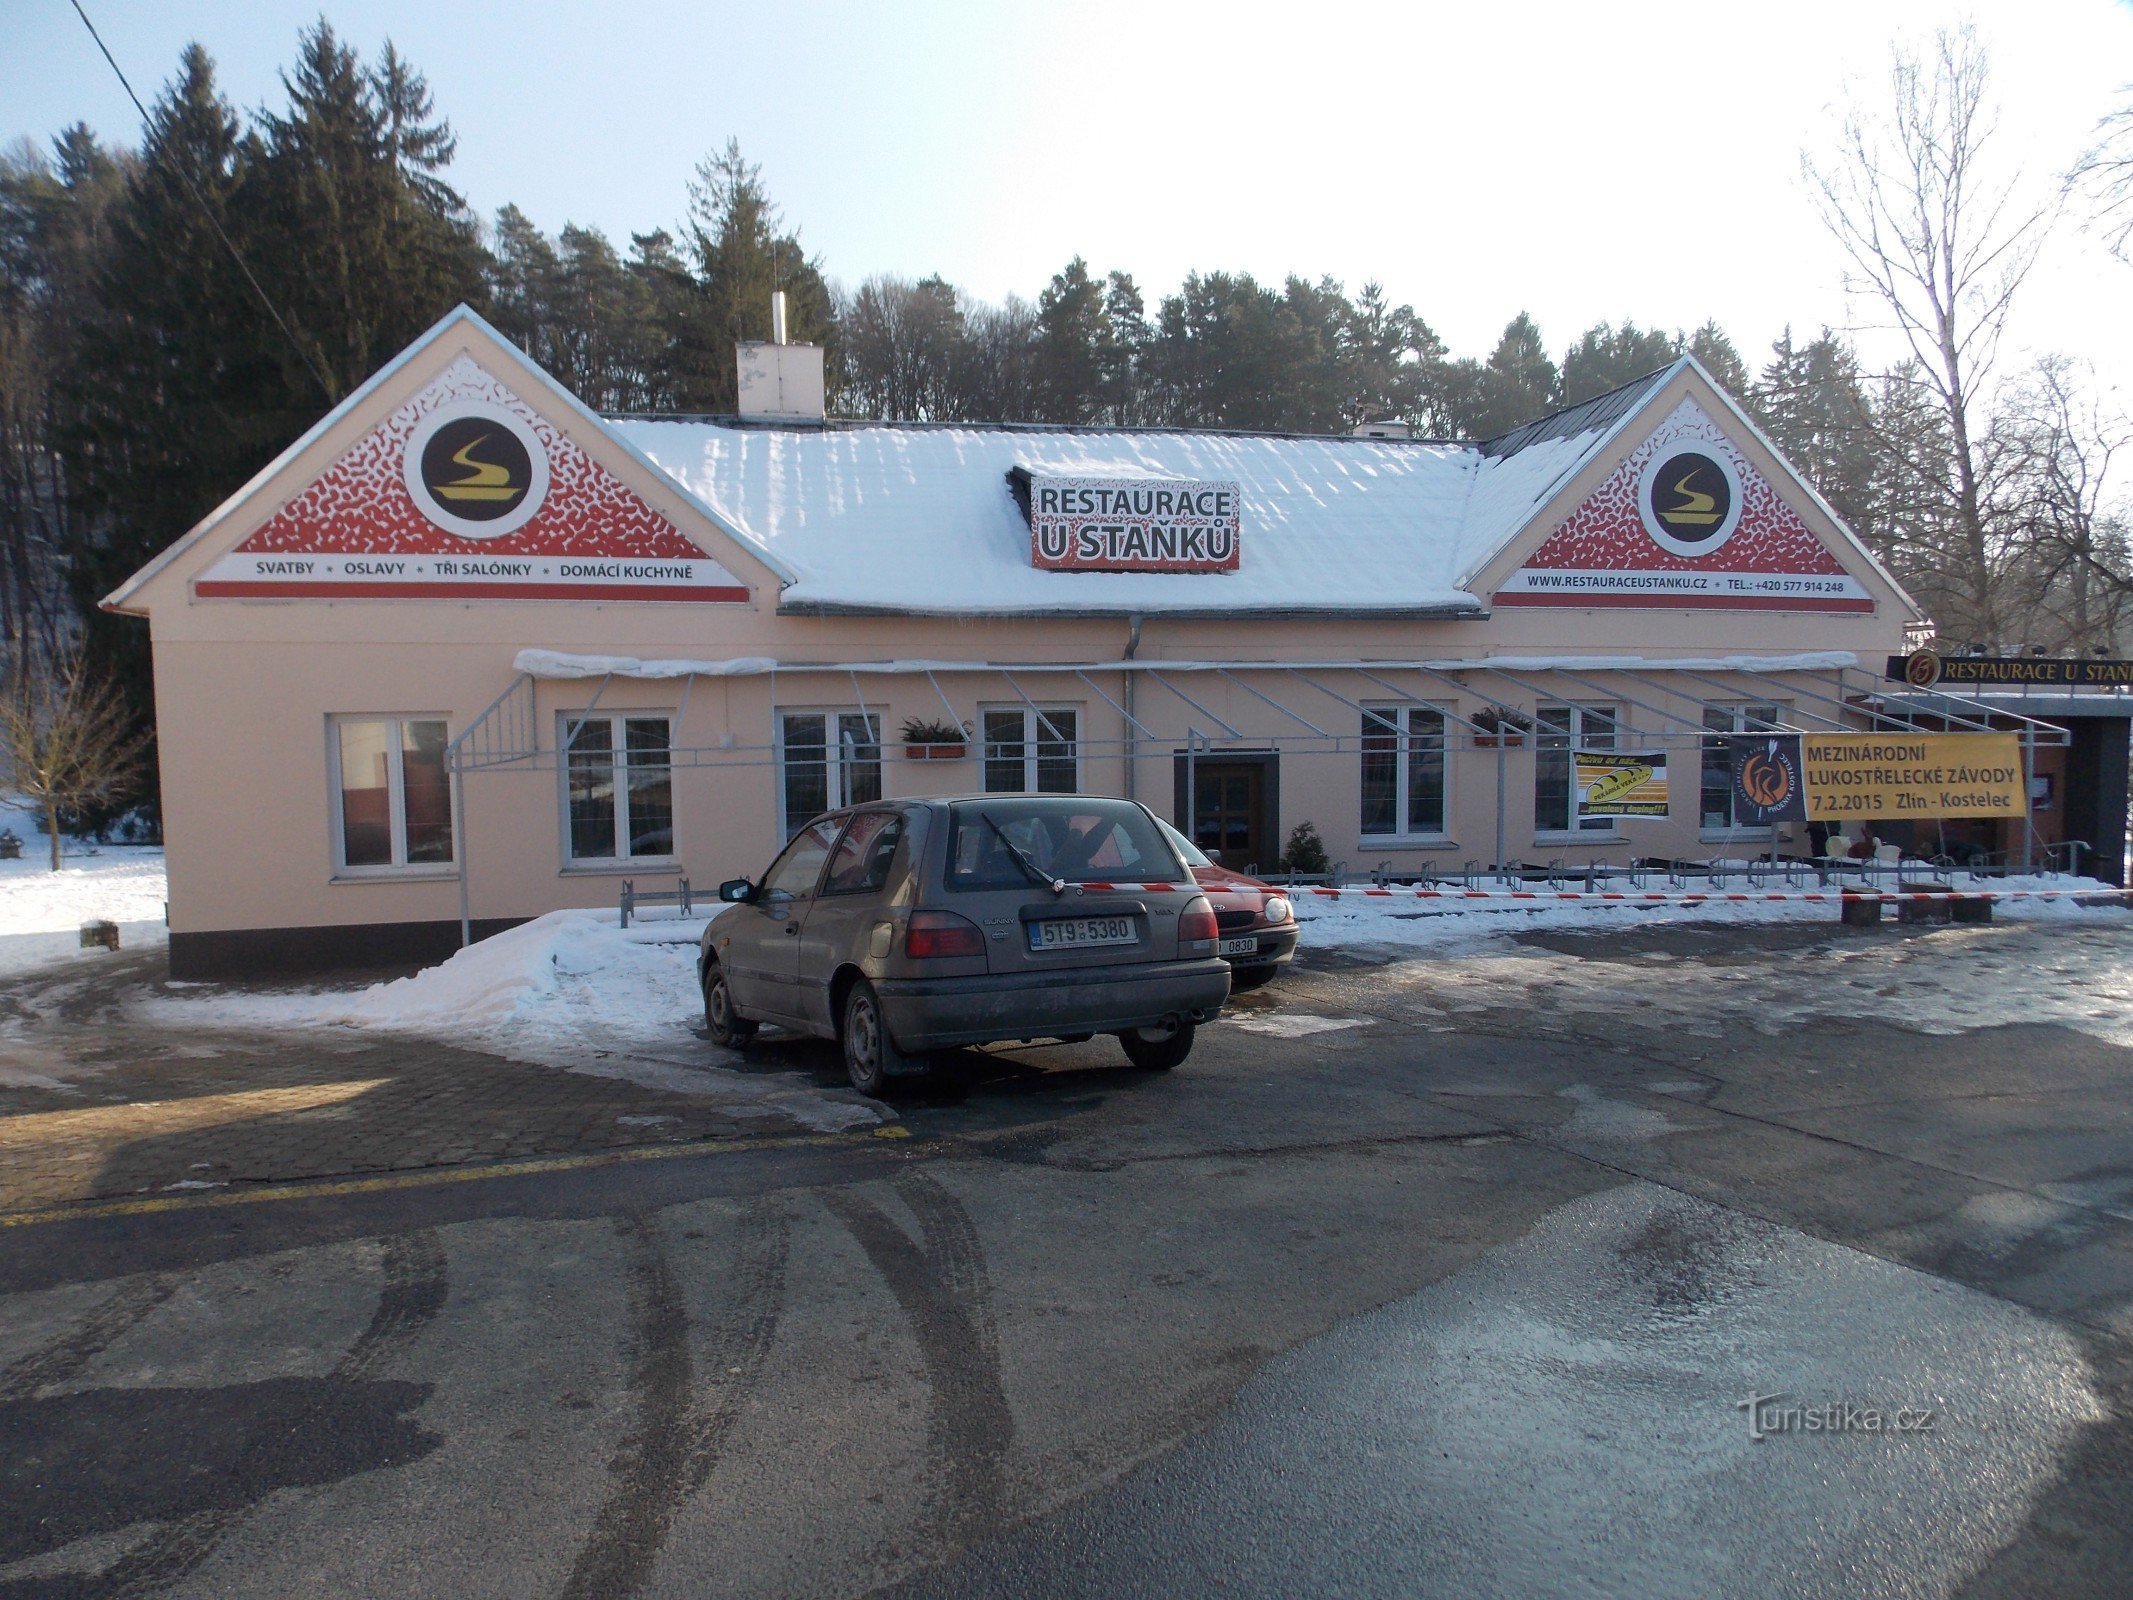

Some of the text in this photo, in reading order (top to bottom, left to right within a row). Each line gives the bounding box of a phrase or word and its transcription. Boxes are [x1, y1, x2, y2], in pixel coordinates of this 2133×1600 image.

[1040, 489, 1231, 517] RESTAURACE
[1041, 518, 1231, 559] U STAŇKŮ
[256, 561, 693, 578] SVATBY OSLAVY TŘI SALÓNKY DOMÁCÍ KUCHYNĚ
[1527, 575, 1844, 592] WWW.RESTAURACEUSTANKU.CZ TEL.: +420 577 914 248
[1945, 662, 2056, 680] RESTAURACE
[2064, 664, 2078, 680] U
[1807, 743, 1926, 762] MEZINÁRODNÍ
[1767, 753, 1796, 813] PHOENIX KOSTELEC
[1808, 766, 2015, 785] LUKOSTŘELECKÉ ZÁVODY
[1812, 794, 1883, 811] 7.2.2015
[1895, 793, 1927, 809] Zlín
[1939, 791, 2010, 808] Kostelec
[983, 918, 1015, 926] SUNNY
[1044, 921, 1076, 943] 5T9
[1089, 919, 1129, 939] 5380
[1229, 939, 1253, 952] 0830
